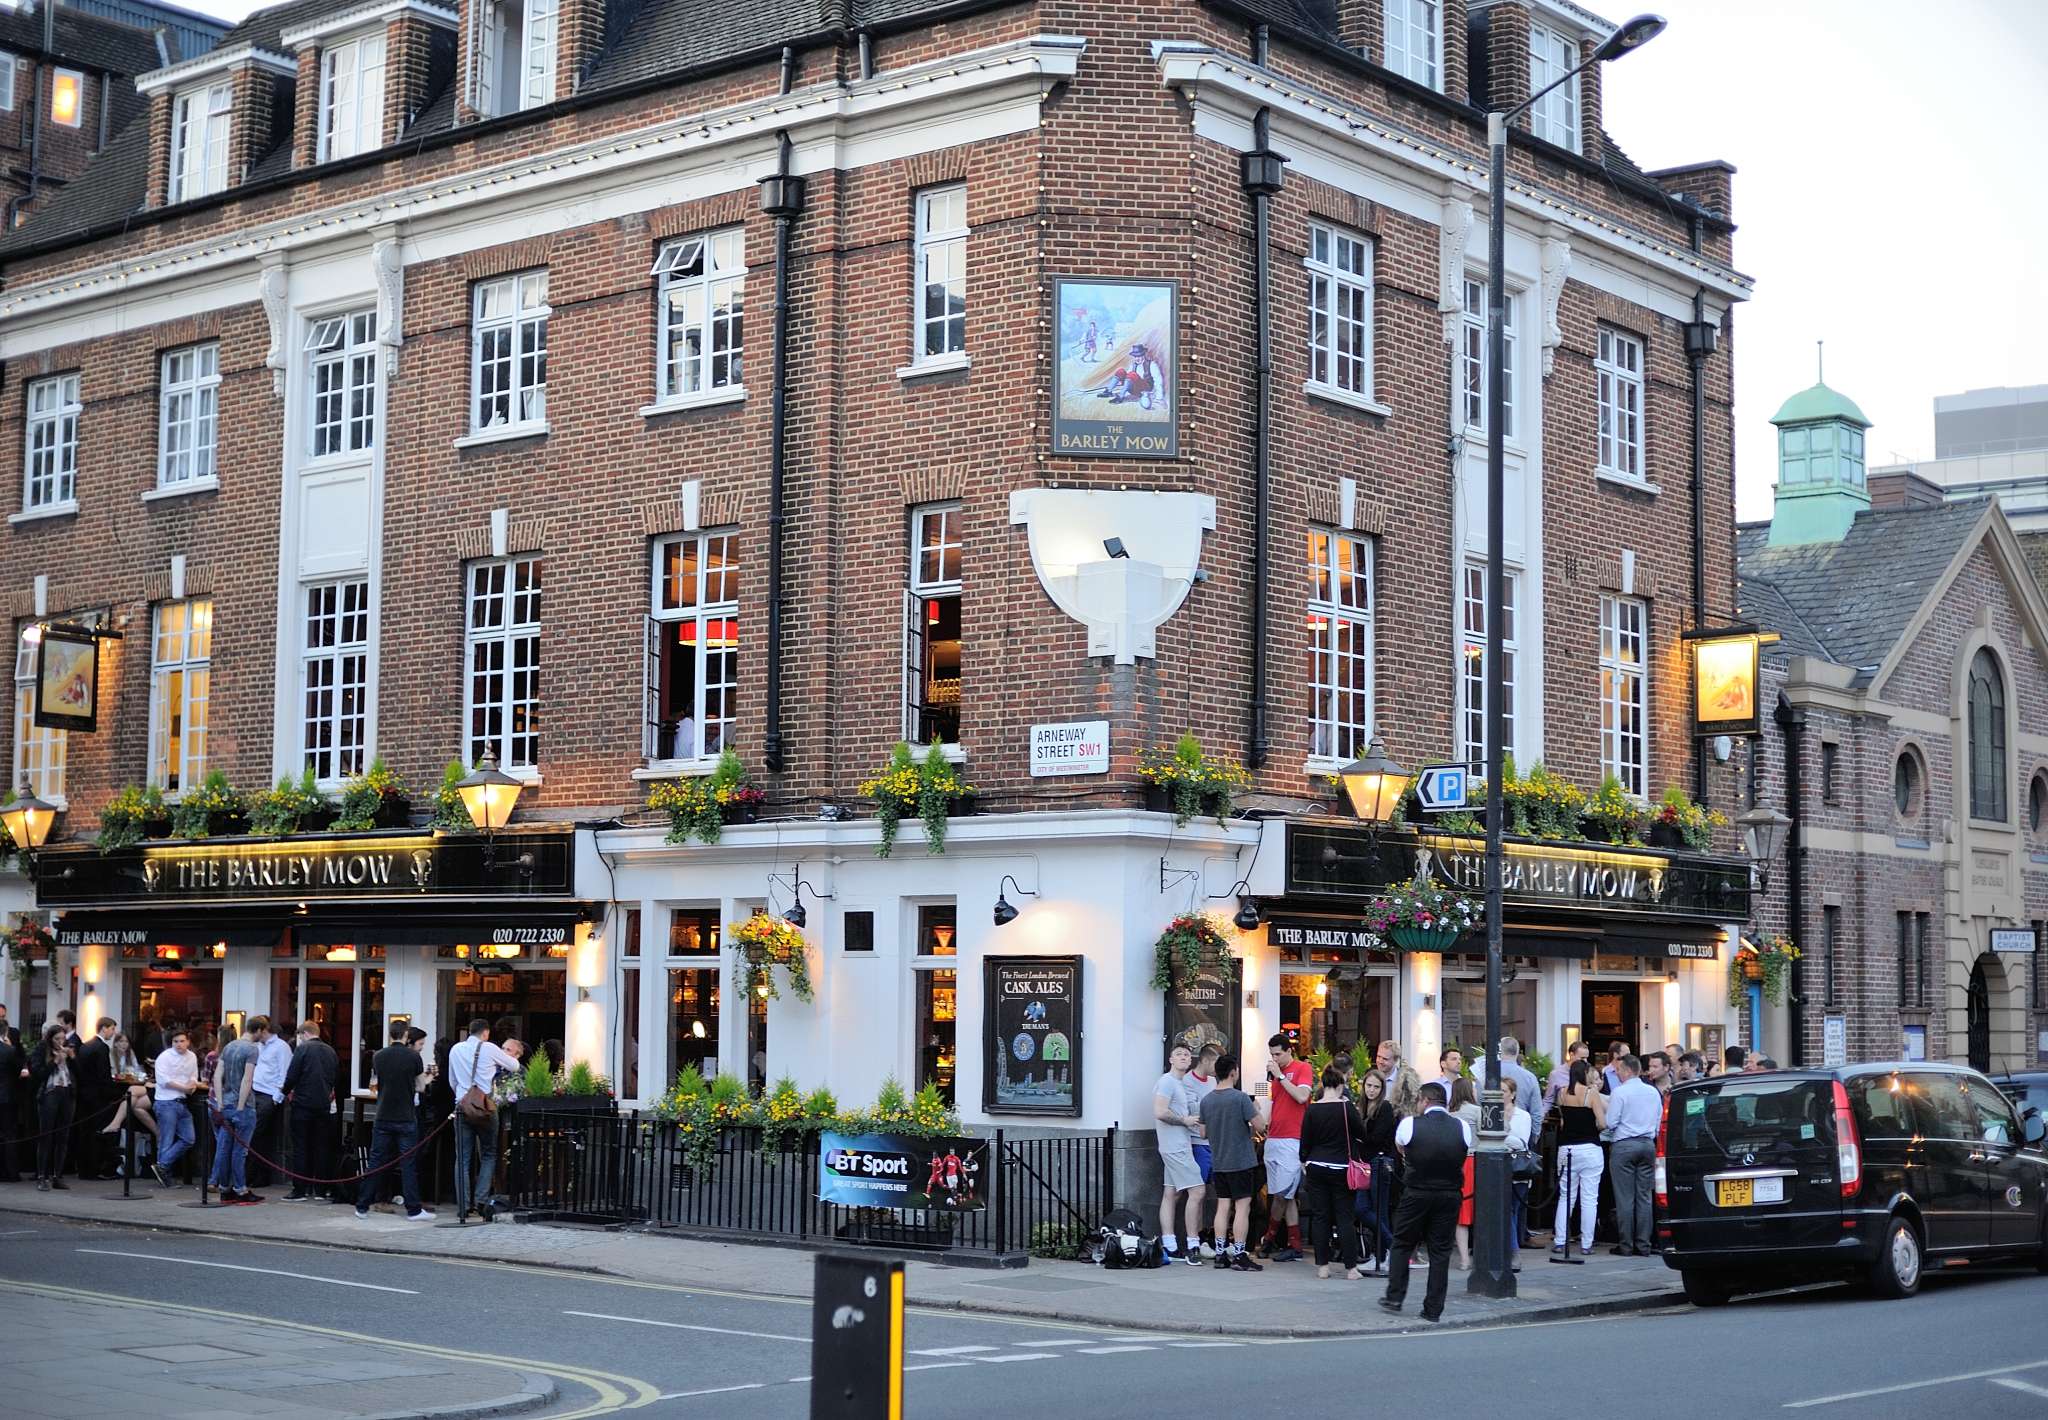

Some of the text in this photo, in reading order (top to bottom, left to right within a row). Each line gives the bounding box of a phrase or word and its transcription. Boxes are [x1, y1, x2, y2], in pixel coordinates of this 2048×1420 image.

[1106, 425, 1124, 434] THE
[1061, 434, 1169, 450] BARLEY MOW
[1037, 727, 1087, 743] ARNEWAY
[1037, 743, 1101, 759] STREET SW1
[1443, 775, 1459, 799] P
[176, 854, 394, 888] THE BARLEY MOW
[1450, 855, 1637, 899] TH BARLEY MOW
[60, 930, 148, 945] THE BARLEY MOW
[492, 928, 565, 943] 020 7222 2330
[1277, 928, 1375, 948] THE BARLEY MO
[1682, 944, 1697, 957] 7222
[1697, 945, 1713, 958] 2330
[1997, 941, 2032, 949] CHURCH
[1001, 971, 1012, 979] The
[1013, 971, 1028, 979] Finest
[1004, 981, 1064, 994] CASK ALES
[1184, 988, 1217, 1000] BRITISH
[834, 1154, 908, 1176] BT Sport
[852, 1181, 868, 1189] SPORT
[868, 1182, 893, 1191] HAPPENS
[893, 1183, 908, 1192] HERE
[1722, 1179, 1750, 1192] LG58
[1726, 1192, 1746, 1204] PLF
